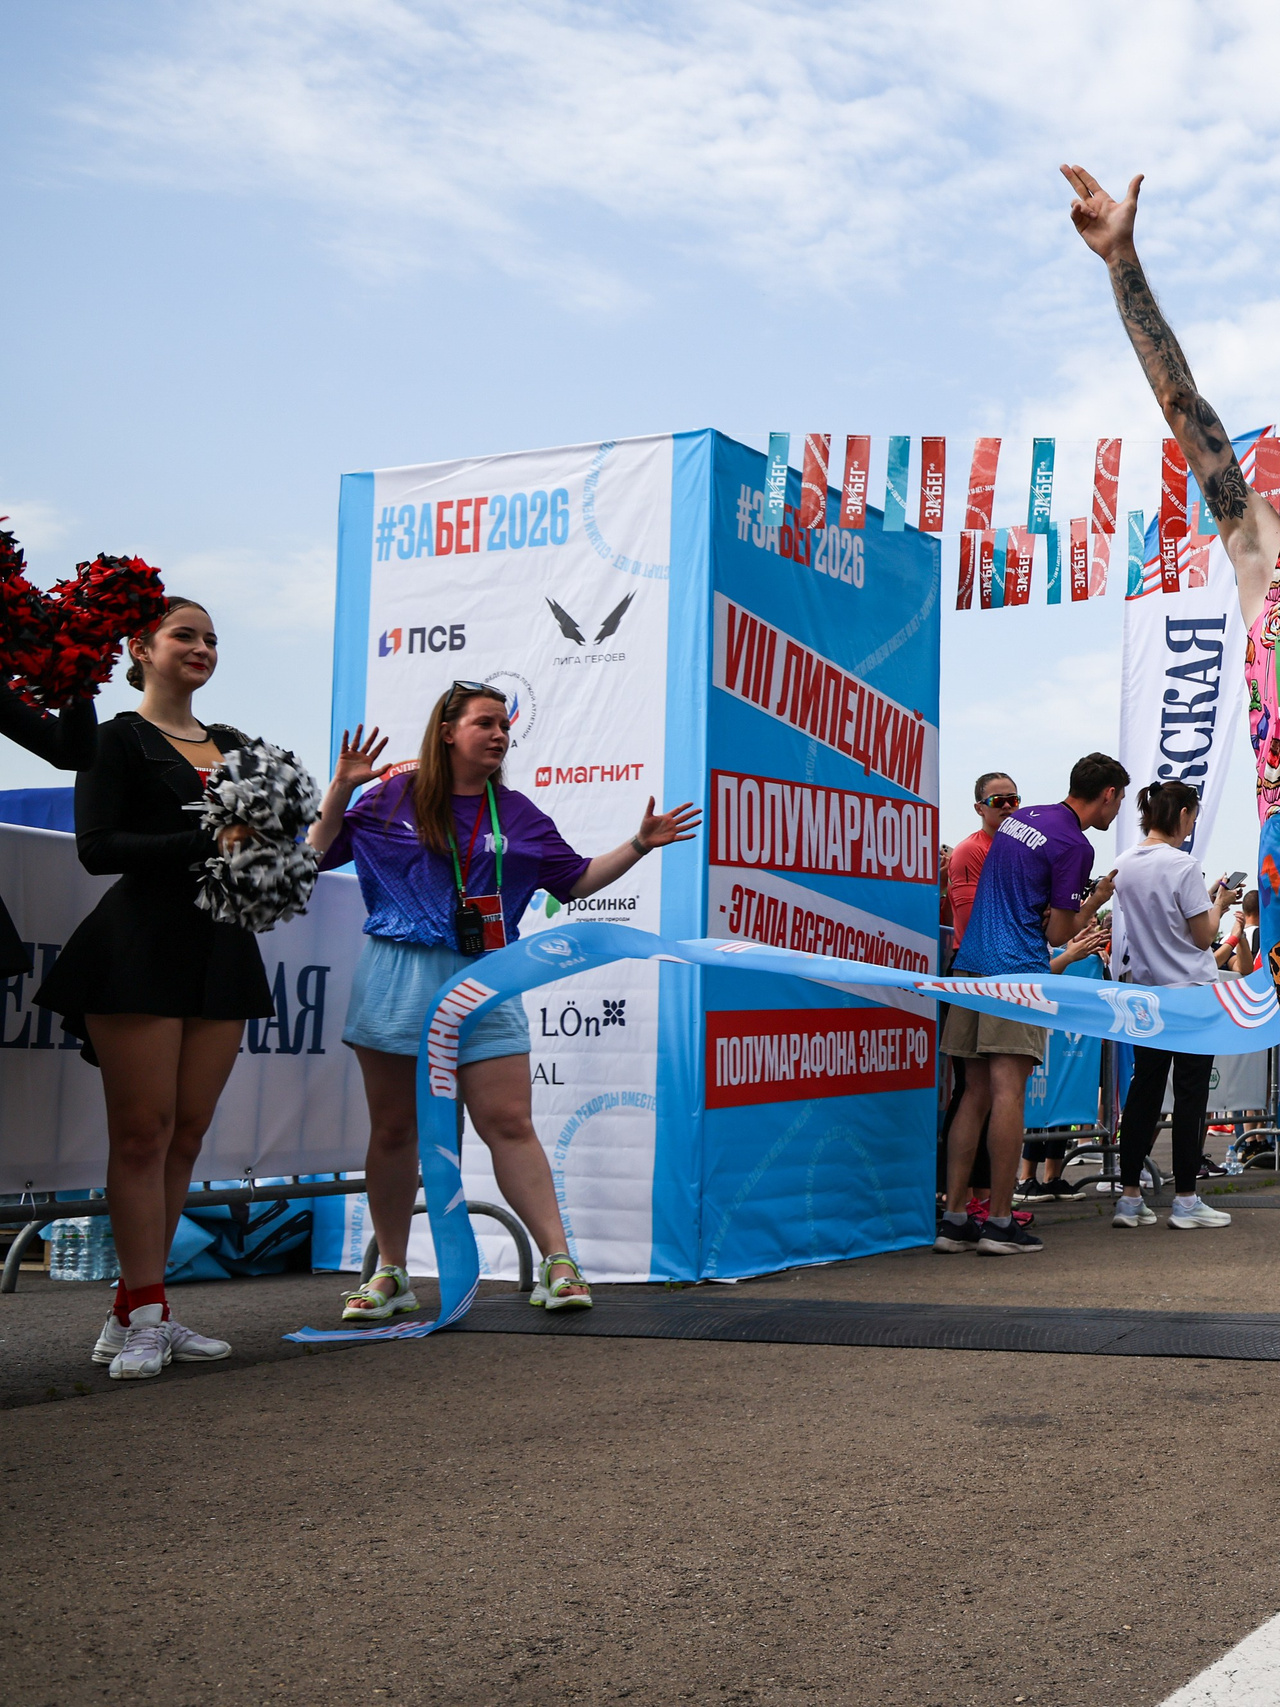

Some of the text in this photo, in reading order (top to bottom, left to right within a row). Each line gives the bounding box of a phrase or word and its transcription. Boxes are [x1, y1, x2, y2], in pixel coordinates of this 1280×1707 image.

[376, 488, 569, 561] #ЗАБЕГ2026
[408, 624, 466, 654] ПСБ
[552, 653, 626, 666] ЛИГА ГЕРОЕВ
[725, 602, 925, 795] VIII ЛИПЕЦКИЙ
[717, 774, 933, 880] ПОЛУМАРАФОН
[729, 884, 787, 949] ЭТАПА
[716, 1026, 929, 1087] ПОЛУМАРАФОНА ЗАБЕГ.РФ
[553, 1117, 581, 1161] СТАВИМ
[575, 1092, 620, 1123] РЕКОРДЫ
